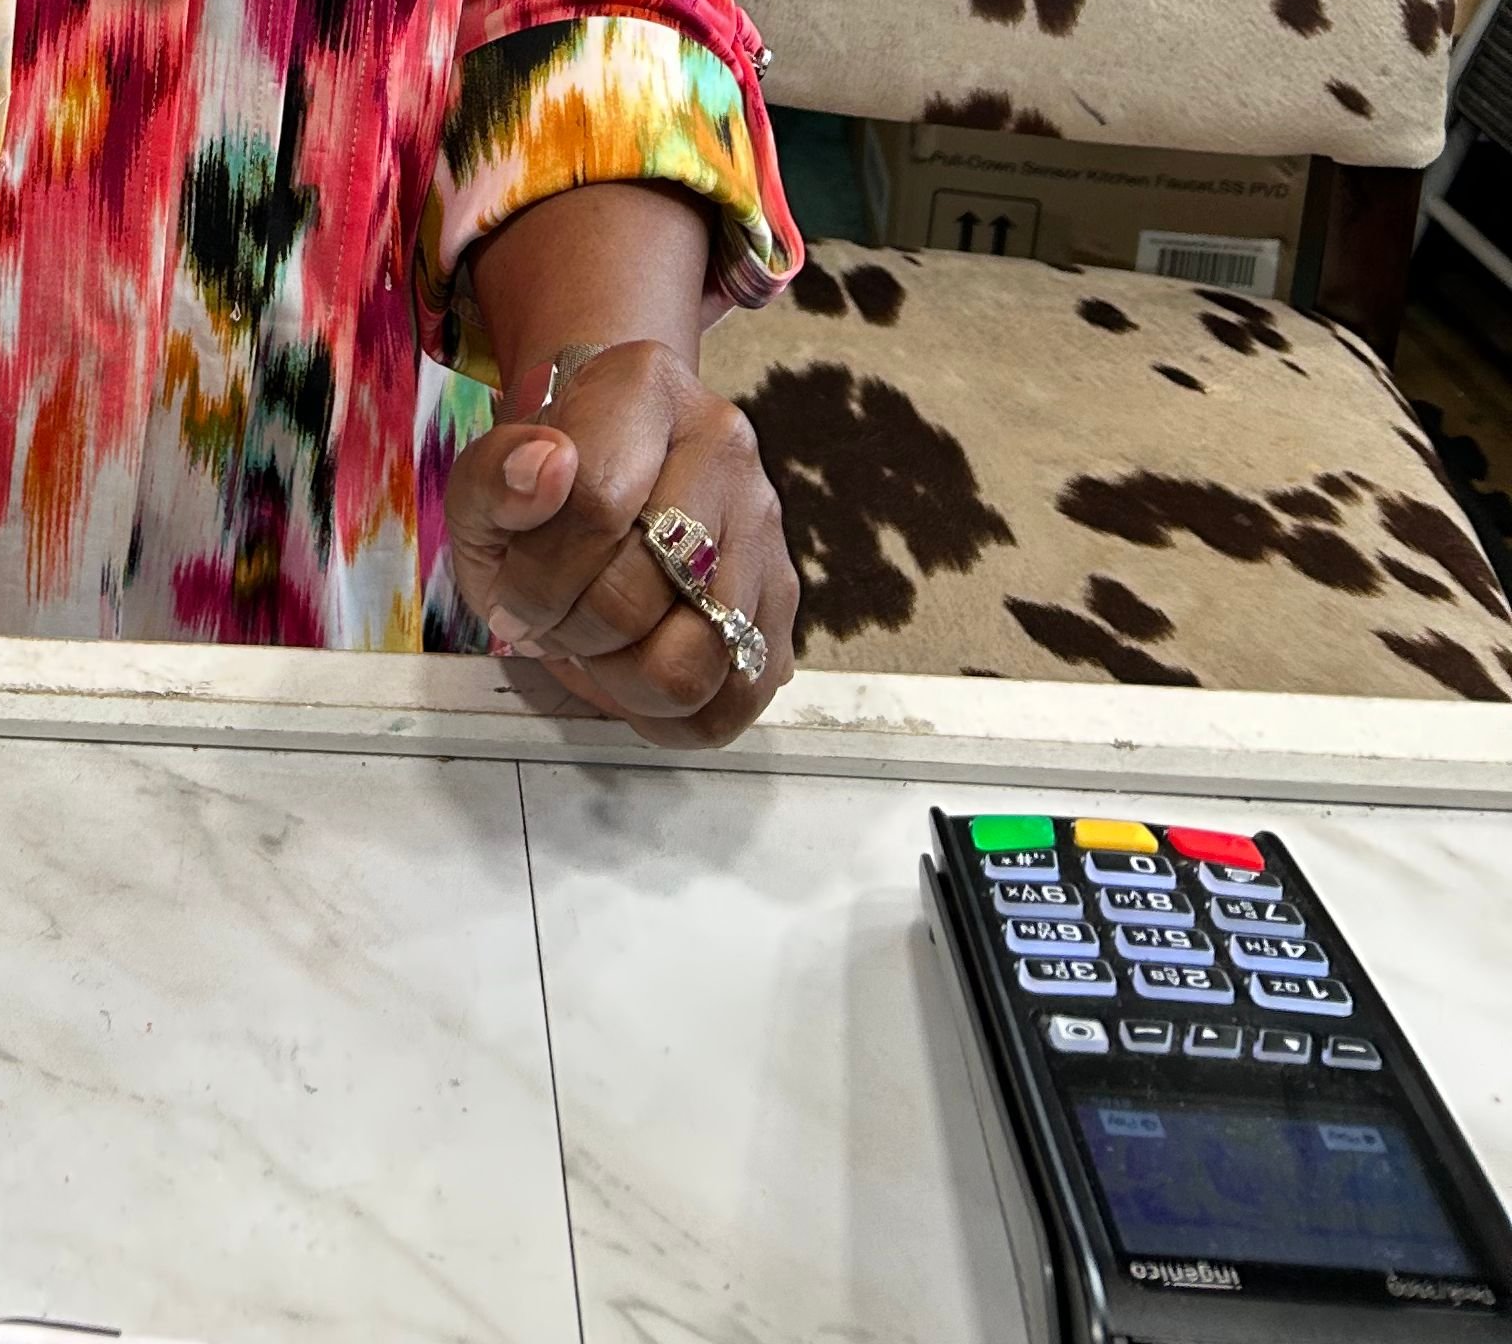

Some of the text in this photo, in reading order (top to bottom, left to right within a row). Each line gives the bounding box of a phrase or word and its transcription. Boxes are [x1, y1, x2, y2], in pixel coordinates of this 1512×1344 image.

[1022, 161, 1079, 180] Sensor
[1086, 168, 1150, 188] Kitchen
[1042, 885, 1066, 903] 9
[1145, 893, 1173, 911] 8
[1264, 904, 1287, 921] 7
[1057, 924, 1082, 941] 6
[1163, 929, 1191, 947] 5
[1281, 941, 1306, 958] 4
[1071, 963, 1095, 981] 3
[1183, 968, 1211, 988] 2
[1306, 979, 1329, 1000] 1
[1129, 1261, 1243, 1291] ingenico
